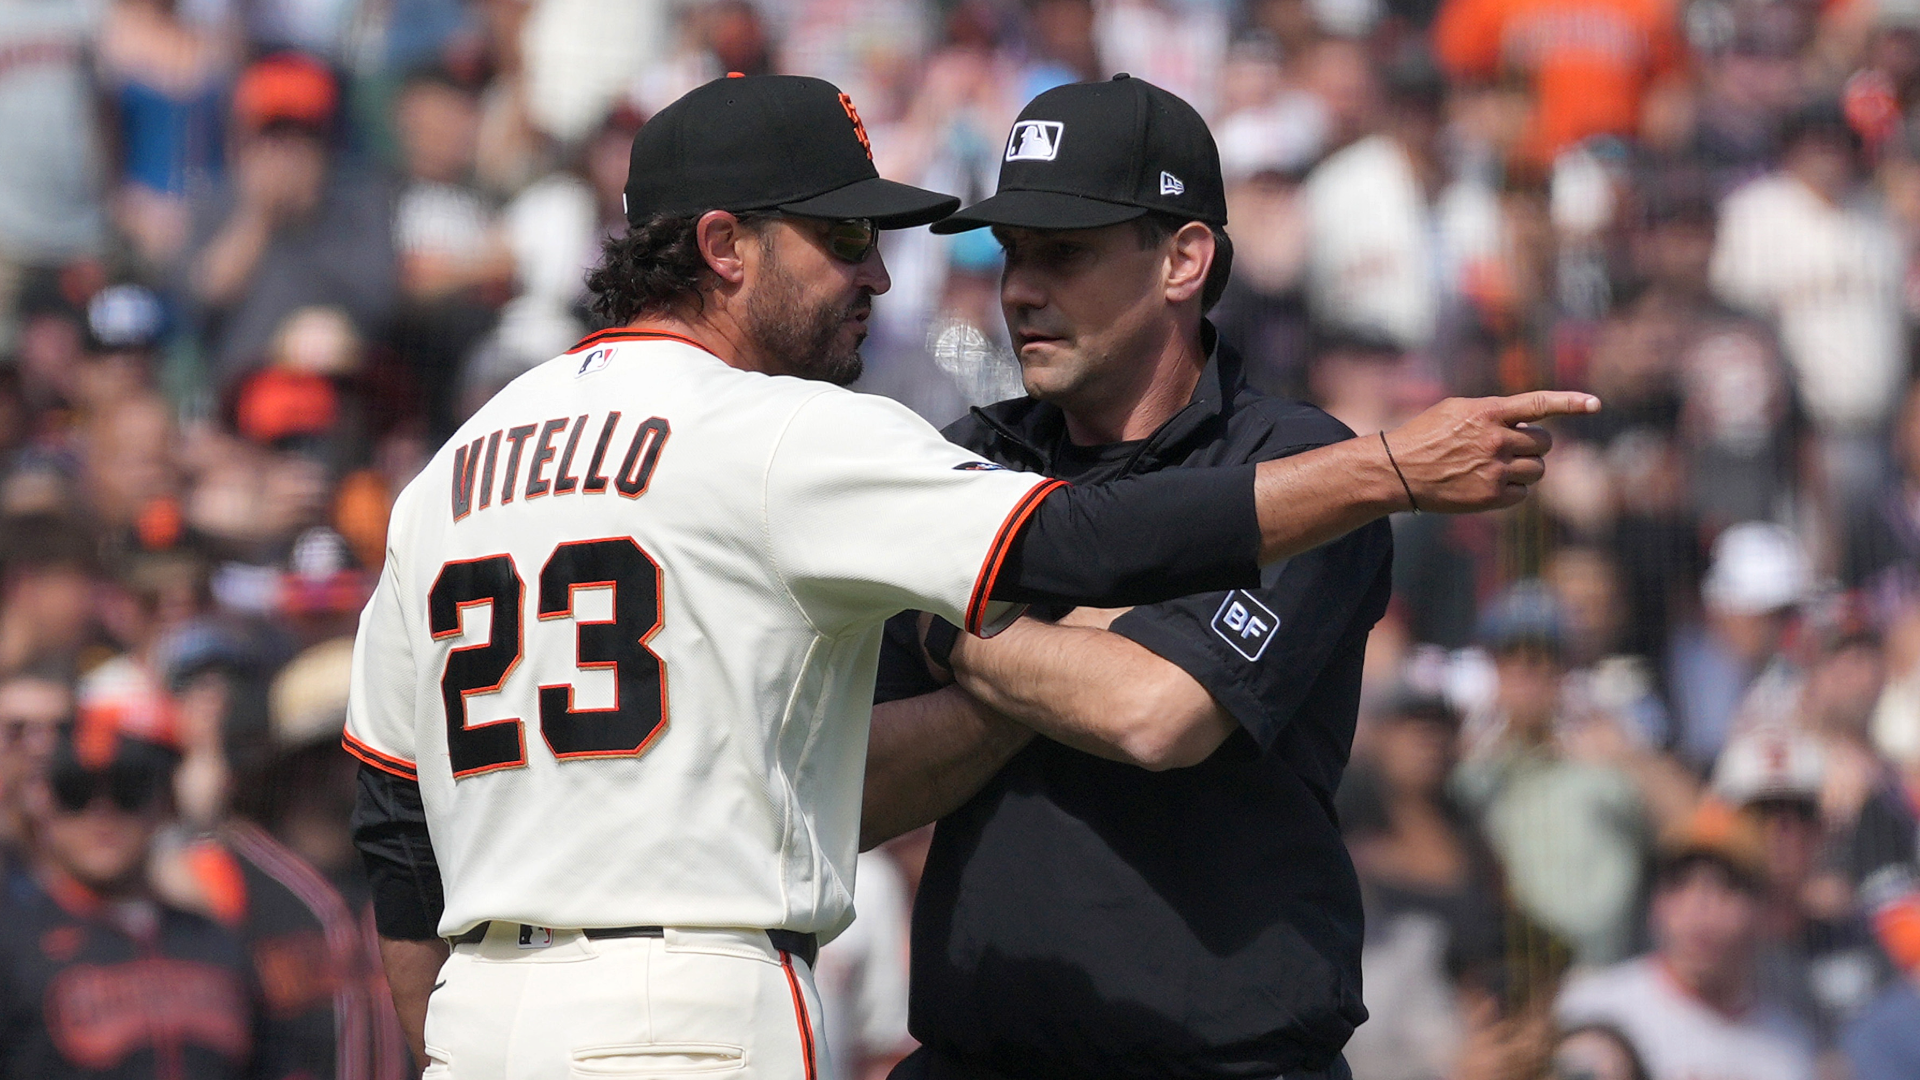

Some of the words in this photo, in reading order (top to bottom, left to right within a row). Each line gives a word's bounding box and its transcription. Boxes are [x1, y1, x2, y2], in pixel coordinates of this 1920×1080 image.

[452, 411, 672, 523] VITELLO
[428, 536, 670, 781] 23
[1223, 601, 1268, 639] BF
